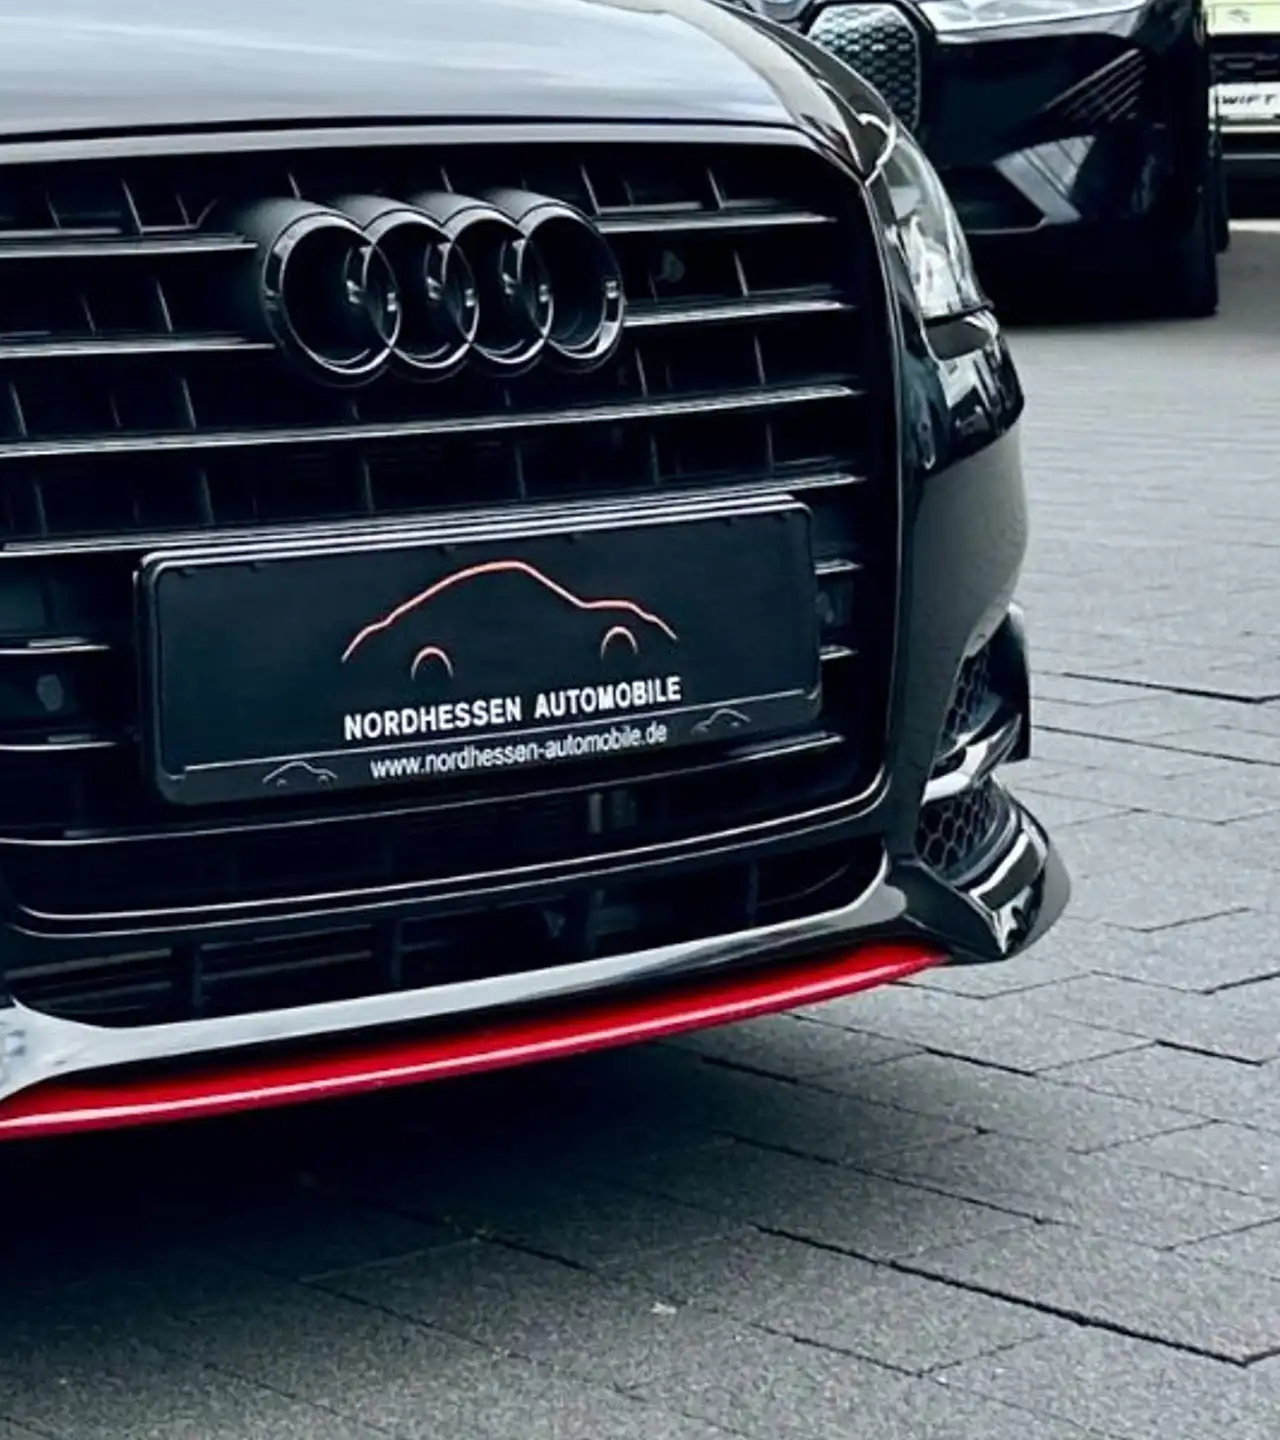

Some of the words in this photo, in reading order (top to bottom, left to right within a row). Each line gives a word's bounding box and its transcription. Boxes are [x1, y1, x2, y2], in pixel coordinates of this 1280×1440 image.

[1216, 94, 1278, 105] WIFT
[343, 696, 522, 741] NORDHESSEN
[533, 675, 682, 719] AUTOMOBILE
[369, 720, 668, 779] www.nordhessen-automobile.de
